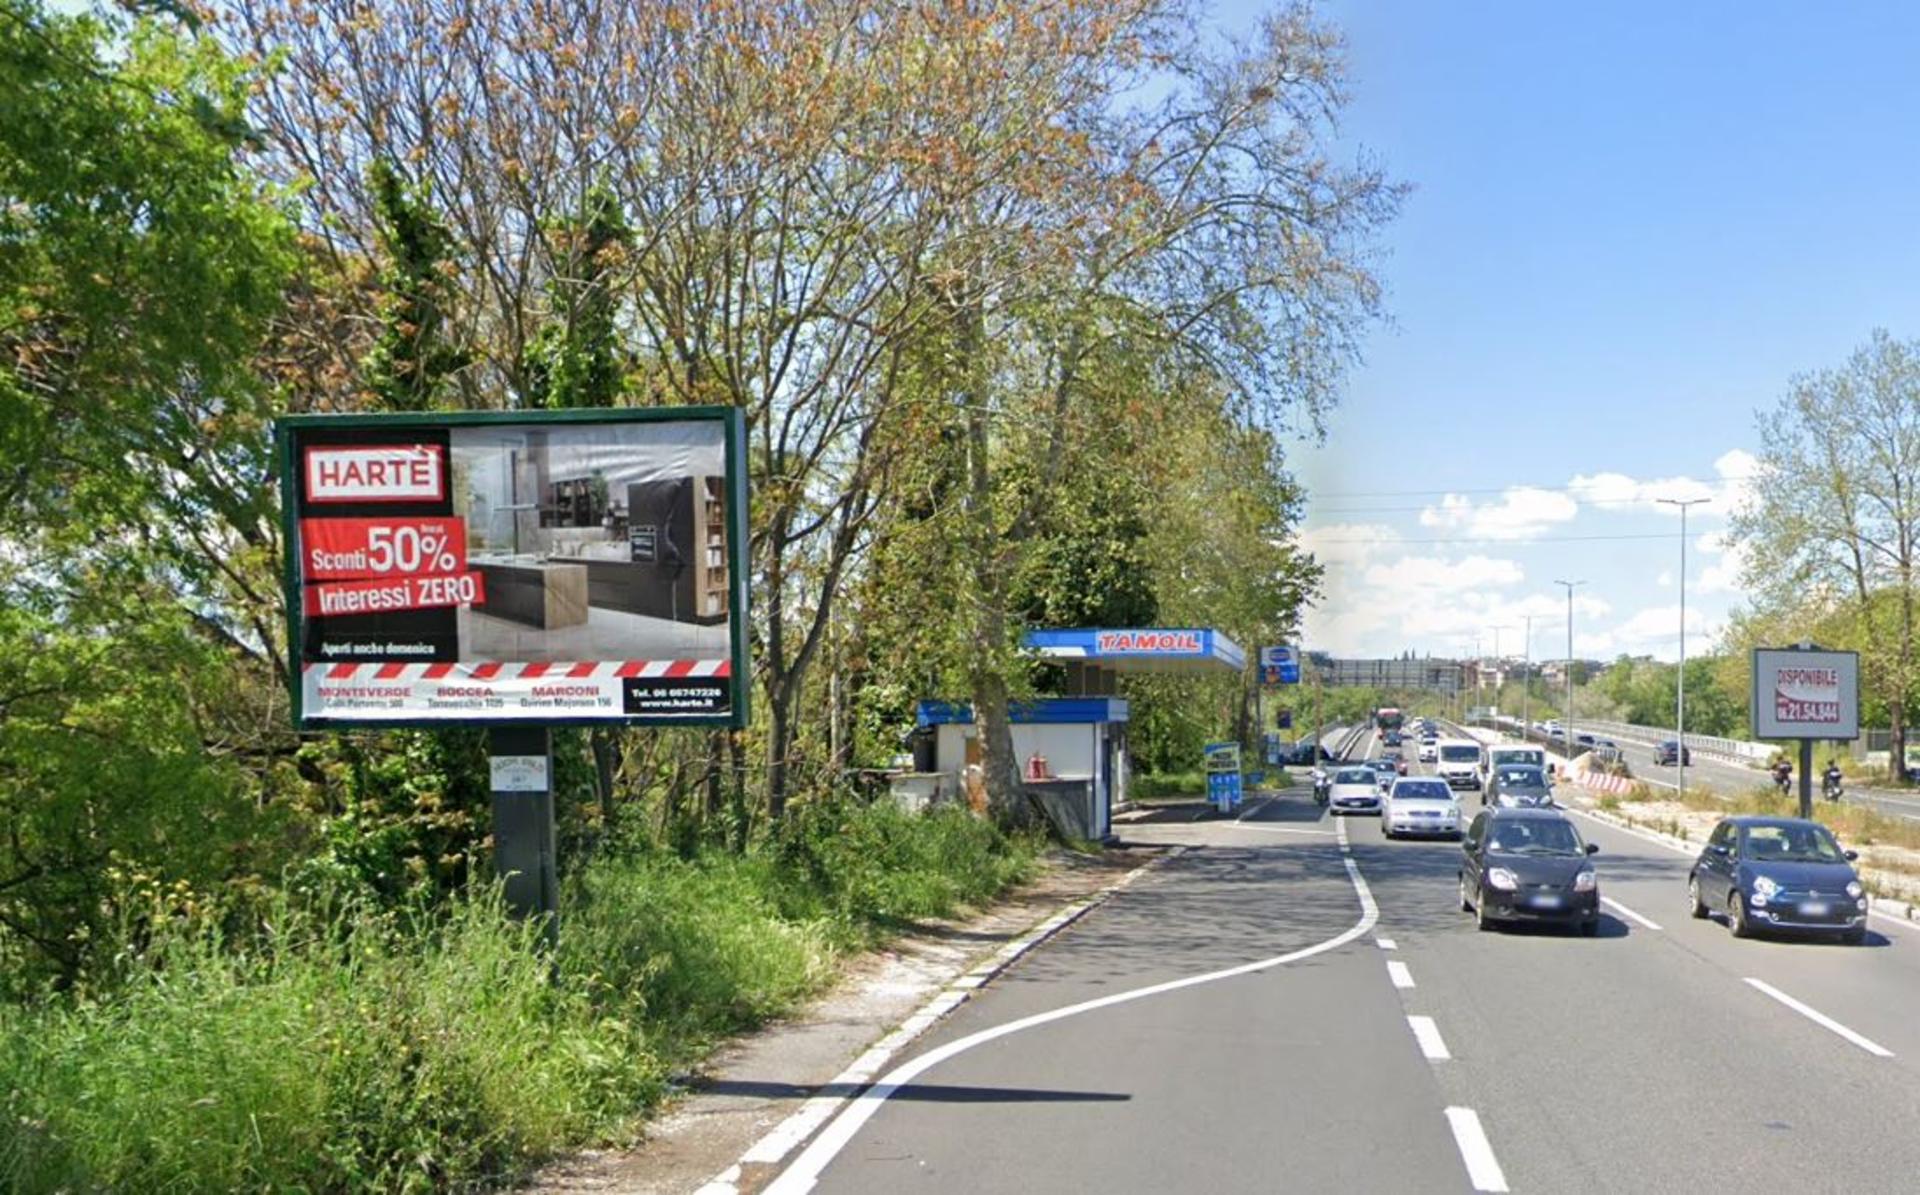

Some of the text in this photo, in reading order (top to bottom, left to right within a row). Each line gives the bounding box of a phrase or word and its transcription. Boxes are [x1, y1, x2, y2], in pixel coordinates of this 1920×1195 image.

[312, 526, 456, 572] Sconti 50%
[318, 575, 475, 615] Interessi ZERO
[1101, 634, 1198, 650] TAMOIL
[1778, 670, 1837, 685] DISPONIBILE
[317, 686, 411, 697] MONTEVERDE
[437, 687, 495, 697] BOCCEA
[531, 685, 600, 697] MARCONI
